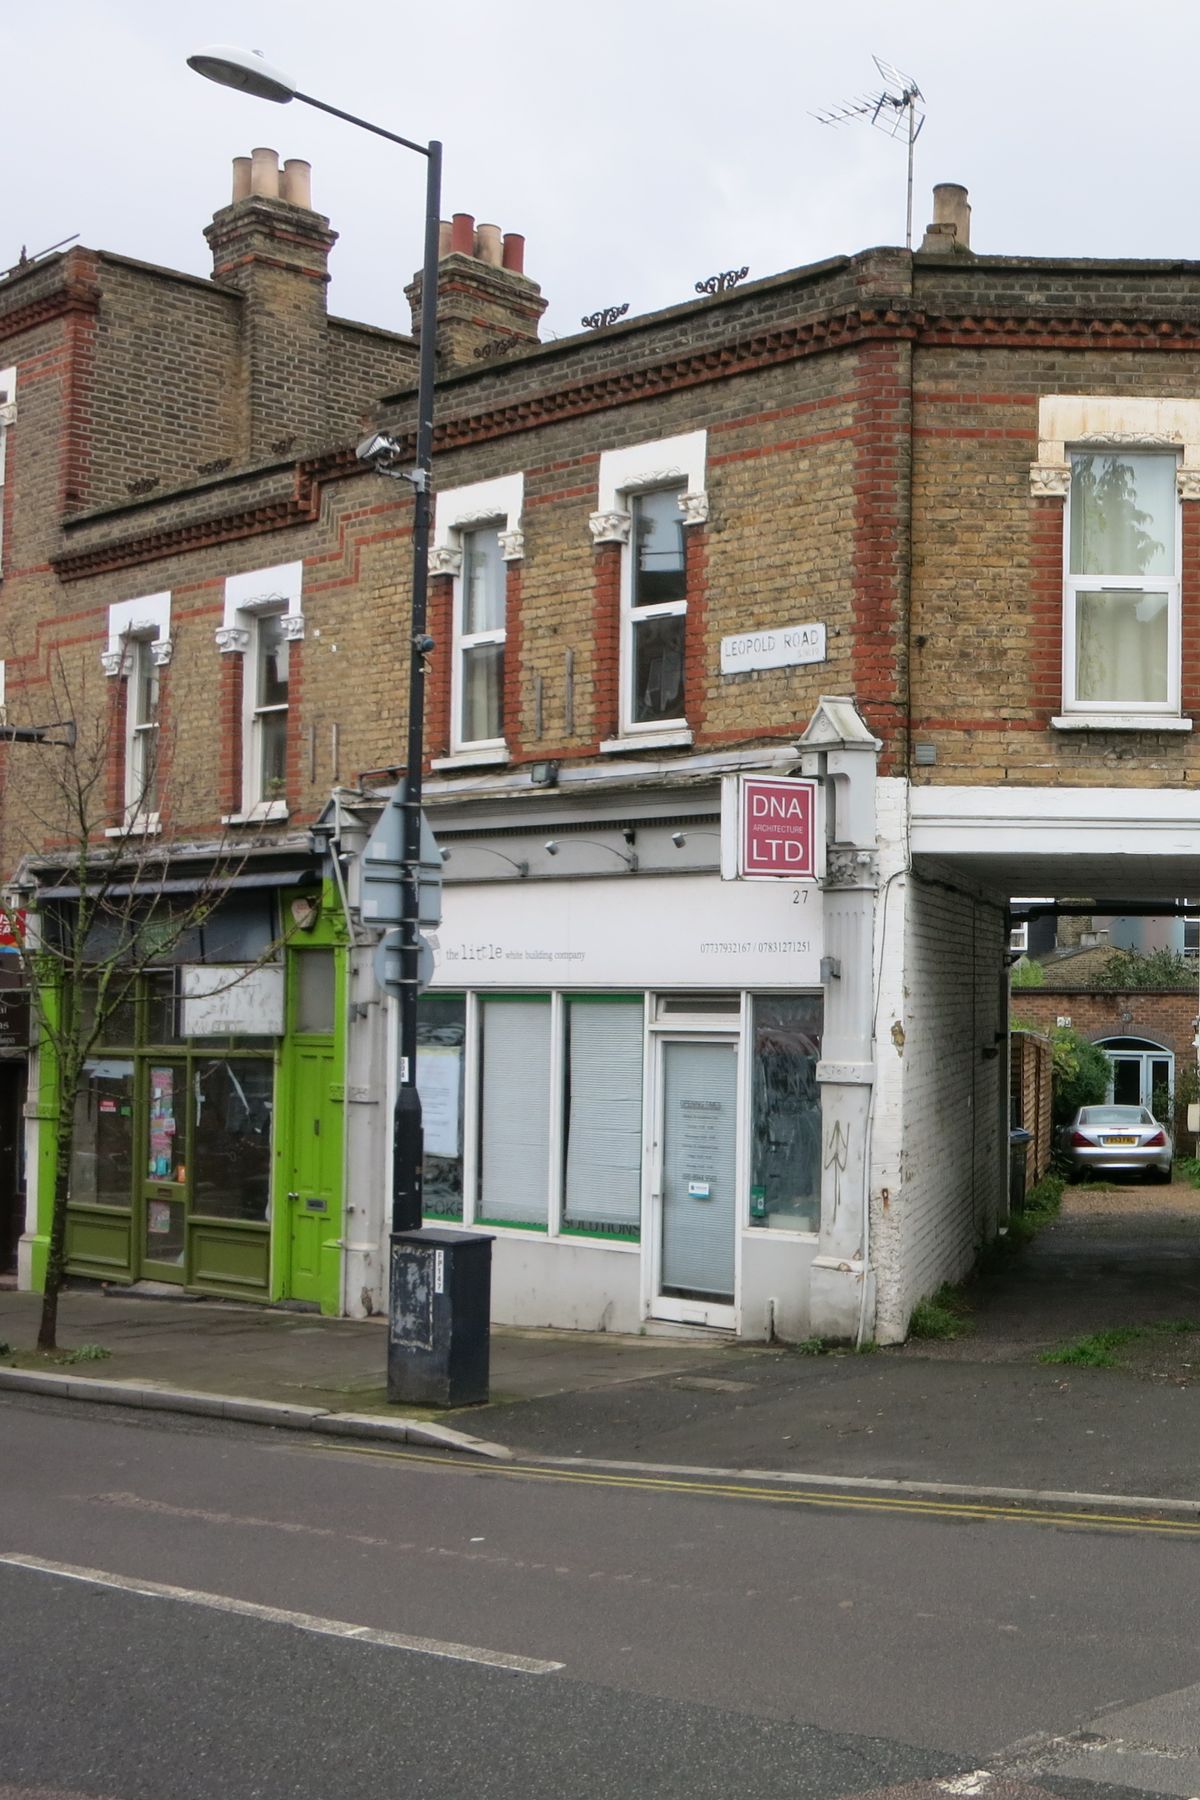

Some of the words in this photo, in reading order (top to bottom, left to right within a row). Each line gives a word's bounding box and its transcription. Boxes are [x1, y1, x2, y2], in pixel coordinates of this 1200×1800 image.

[725, 636, 776, 657] LEOPOLD
[784, 630, 819, 648] ROAD
[753, 795, 803, 819] DNA
[753, 824, 804, 834] ARCHITECTURE
[753, 839, 804, 862] LTD
[793, 890, 808, 904] 27
[446, 948, 459, 960] the
[461, 944, 503, 960] little
[505, 950, 523, 960] white
[525, 950, 553, 962] building
[554, 951, 586, 962] company
[700, 942, 752, 954] 07737932167
[758, 941, 810, 953] 07831271251
